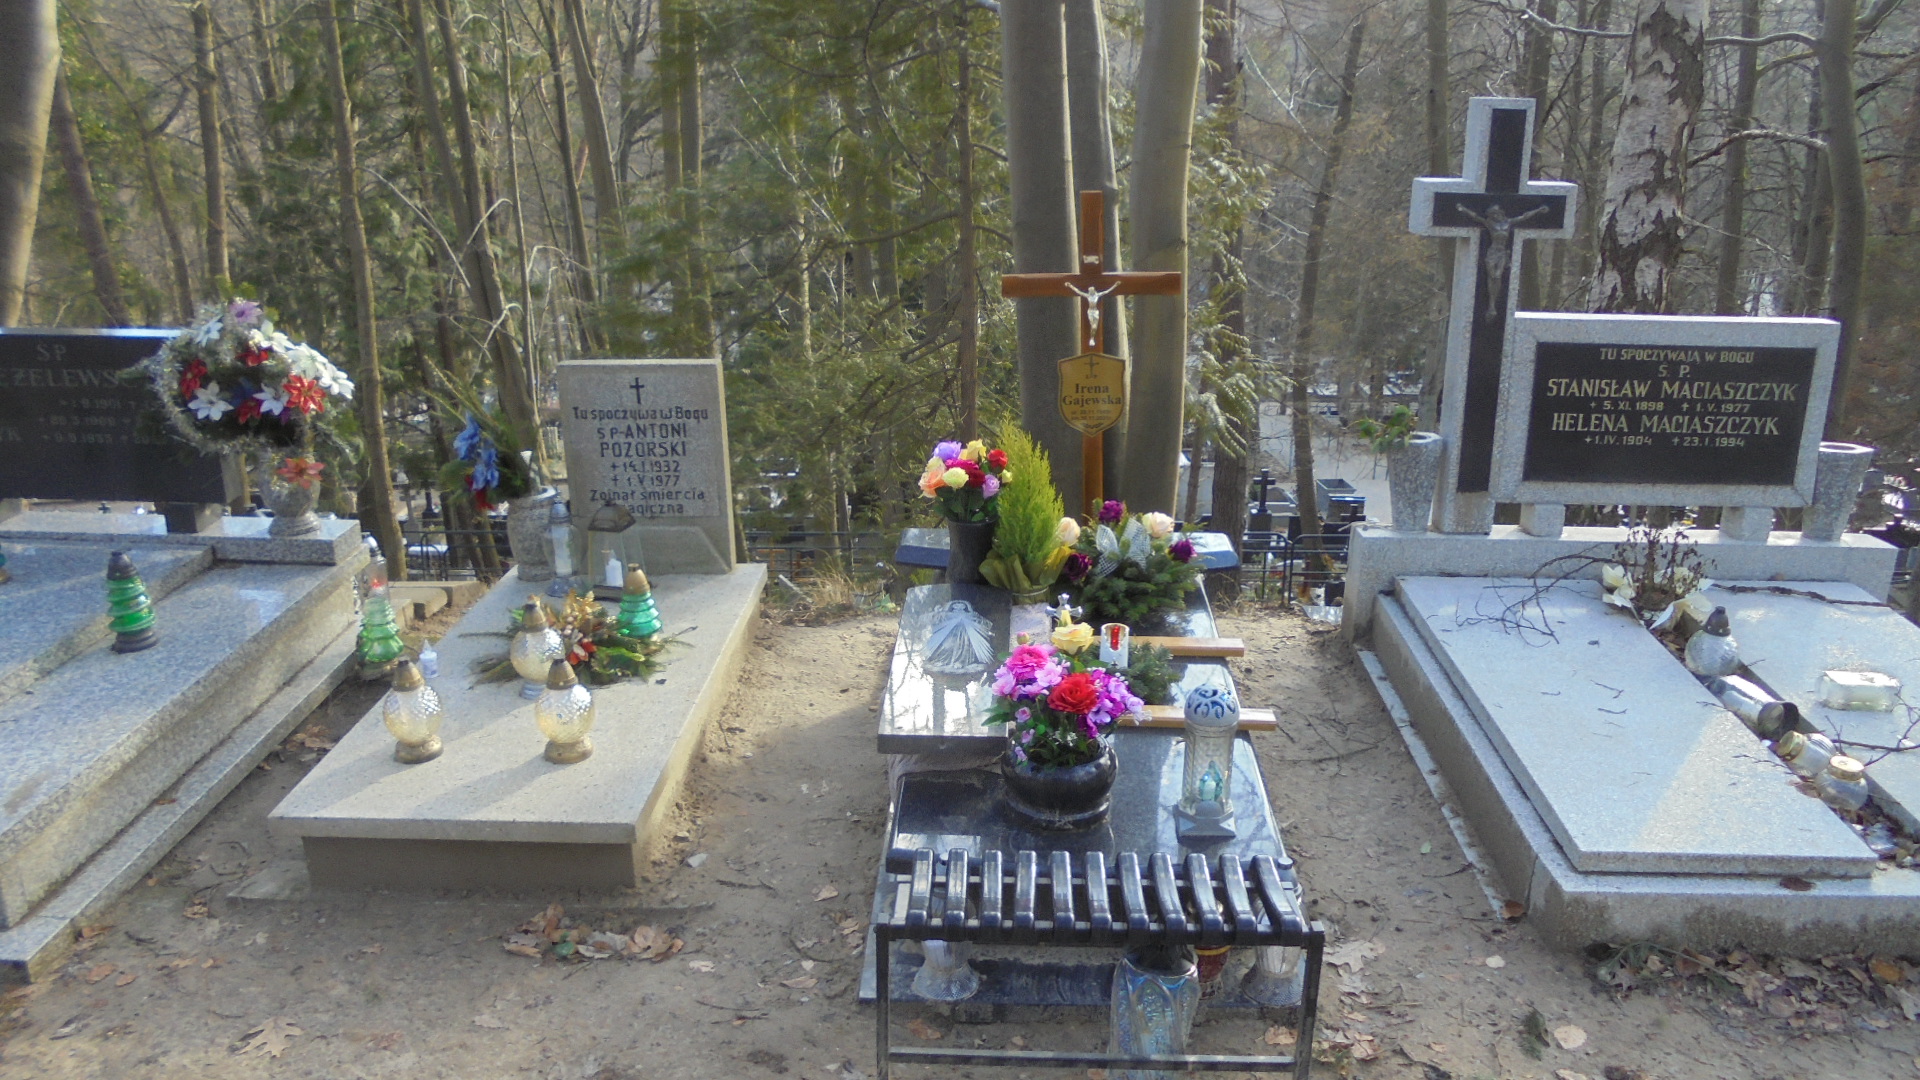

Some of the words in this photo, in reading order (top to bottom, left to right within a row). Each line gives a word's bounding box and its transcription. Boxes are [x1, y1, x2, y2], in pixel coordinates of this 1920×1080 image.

[1600, 348, 1617, 360] TU
[1620, 348, 1700, 363] SPOCZYWAJĄ
[1719, 351, 1754, 363] BOGU
[1075, 383, 1109, 394] Irena
[1547, 378, 1651, 398] STANISŁAW
[1661, 380, 1799, 402] MACIASZCZYK
[1062, 395, 1122, 408] Gajewska
[572, 406, 588, 420] Tu
[590, 408, 657, 421] spoczywa
[675, 405, 709, 424] Bogu
[1551, 412, 1629, 432] HELENA
[1639, 415, 1779, 436] MACIASZCZYK
[600, 440, 686, 458] POZORSKI
